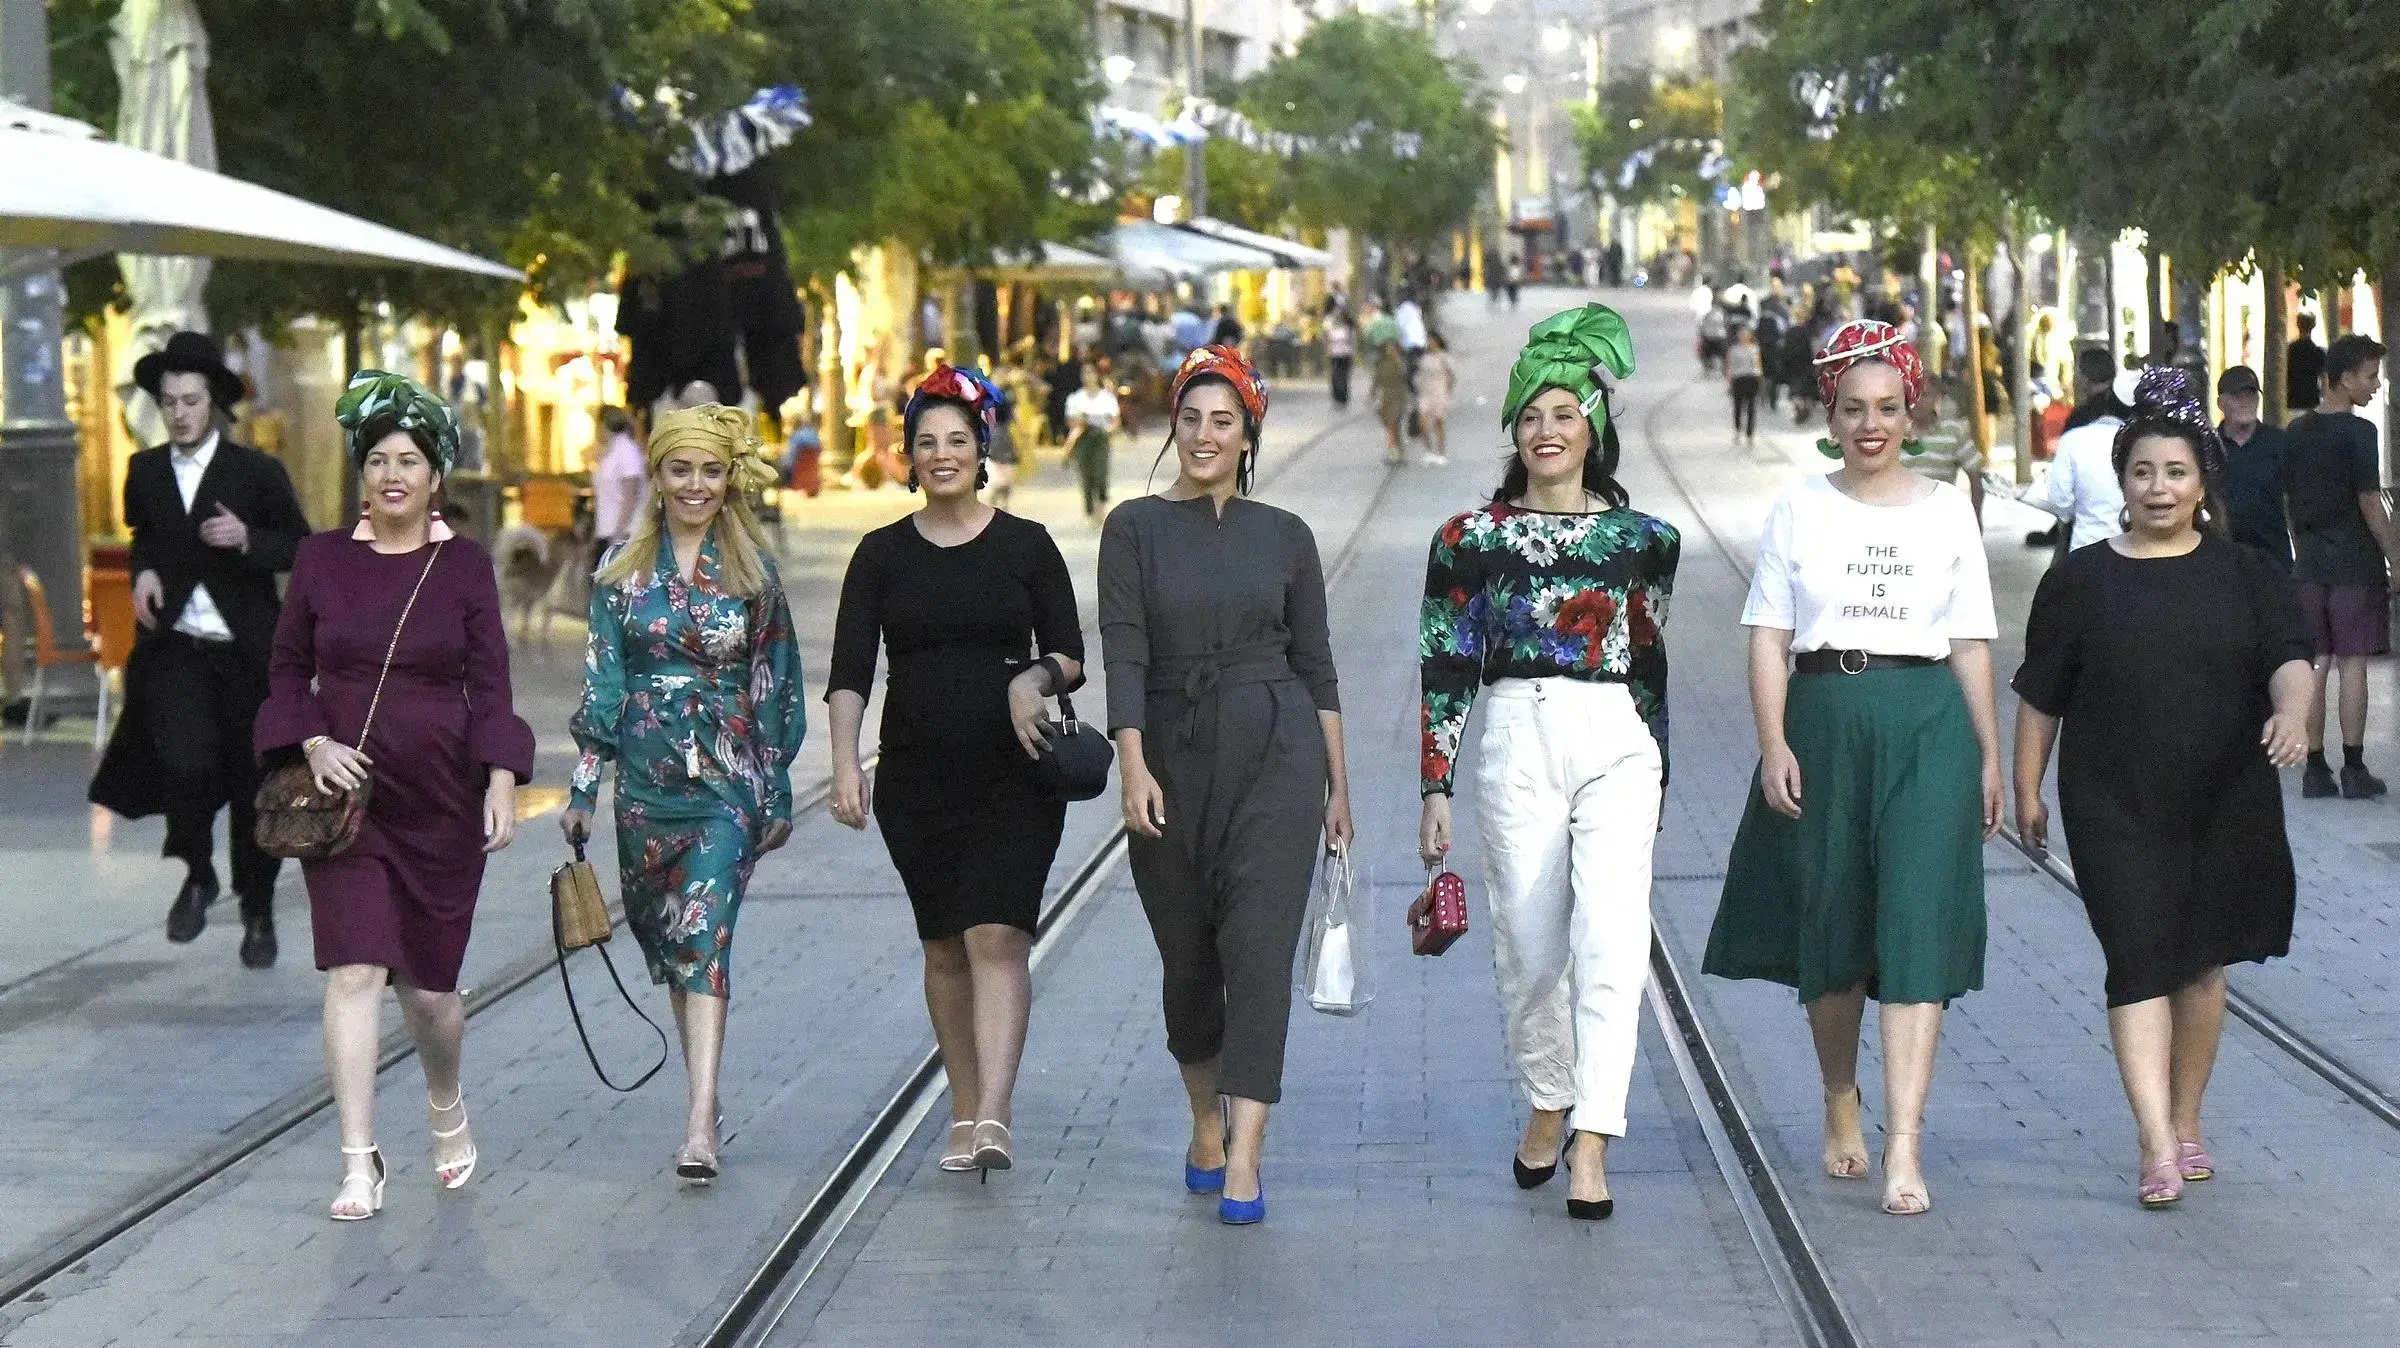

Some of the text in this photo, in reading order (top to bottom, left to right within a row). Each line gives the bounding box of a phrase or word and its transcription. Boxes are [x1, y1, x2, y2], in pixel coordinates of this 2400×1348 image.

[1866, 546, 1898, 558] THE
[1847, 563, 1914, 576] FUTURE
[1871, 583, 1886, 597] IS
[1842, 605, 1910, 620] FEMALE
